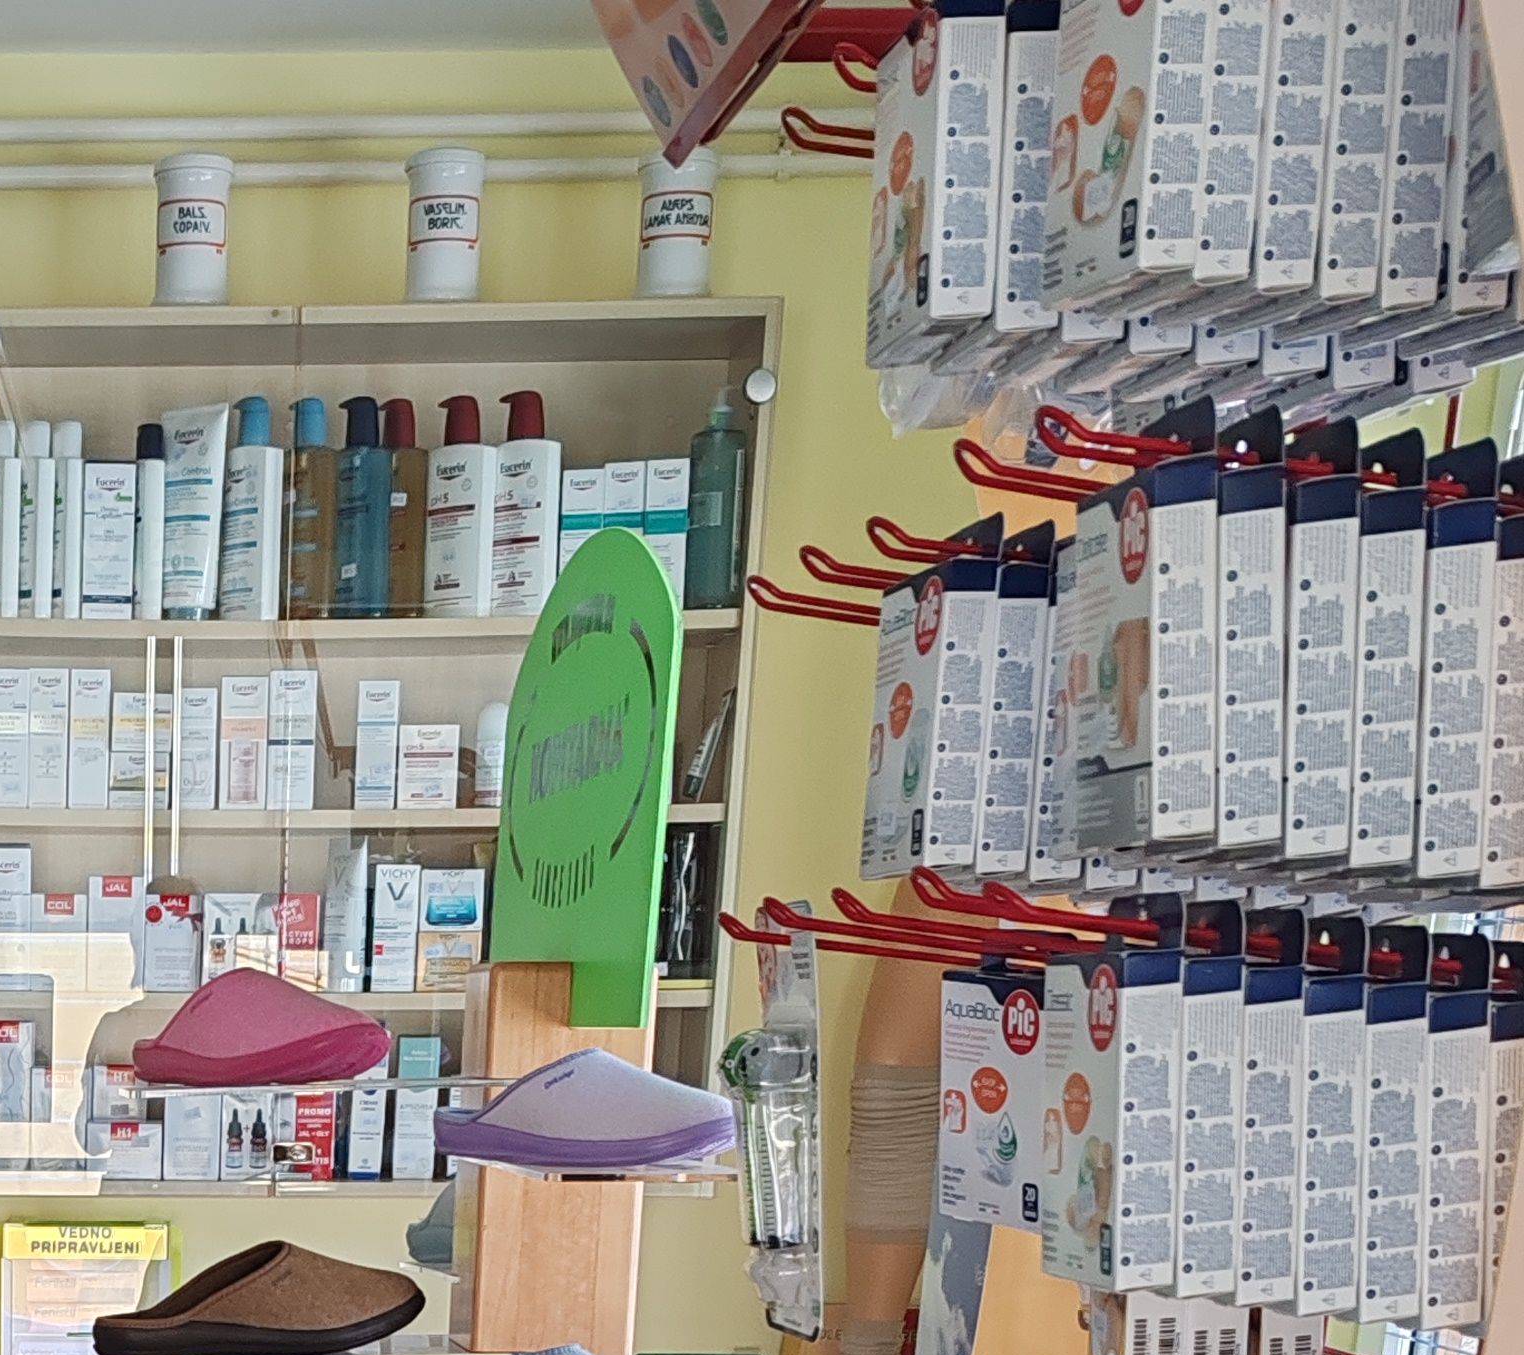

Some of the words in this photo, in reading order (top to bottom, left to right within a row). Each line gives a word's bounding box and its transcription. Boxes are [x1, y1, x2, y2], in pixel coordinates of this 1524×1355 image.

[96, 476, 126, 488] Eucerin
[381, 869, 417, 879] VICHY
[106, 883, 128, 893] JAL
[47, 901, 71, 910] COL
[944, 999, 1001, 1021] AquaBloc
[298, 1108, 331, 1116] PROMO
[59, 1227, 112, 1239] VEDNO
[31, 1241, 140, 1254] PRIPRAVLJENI
